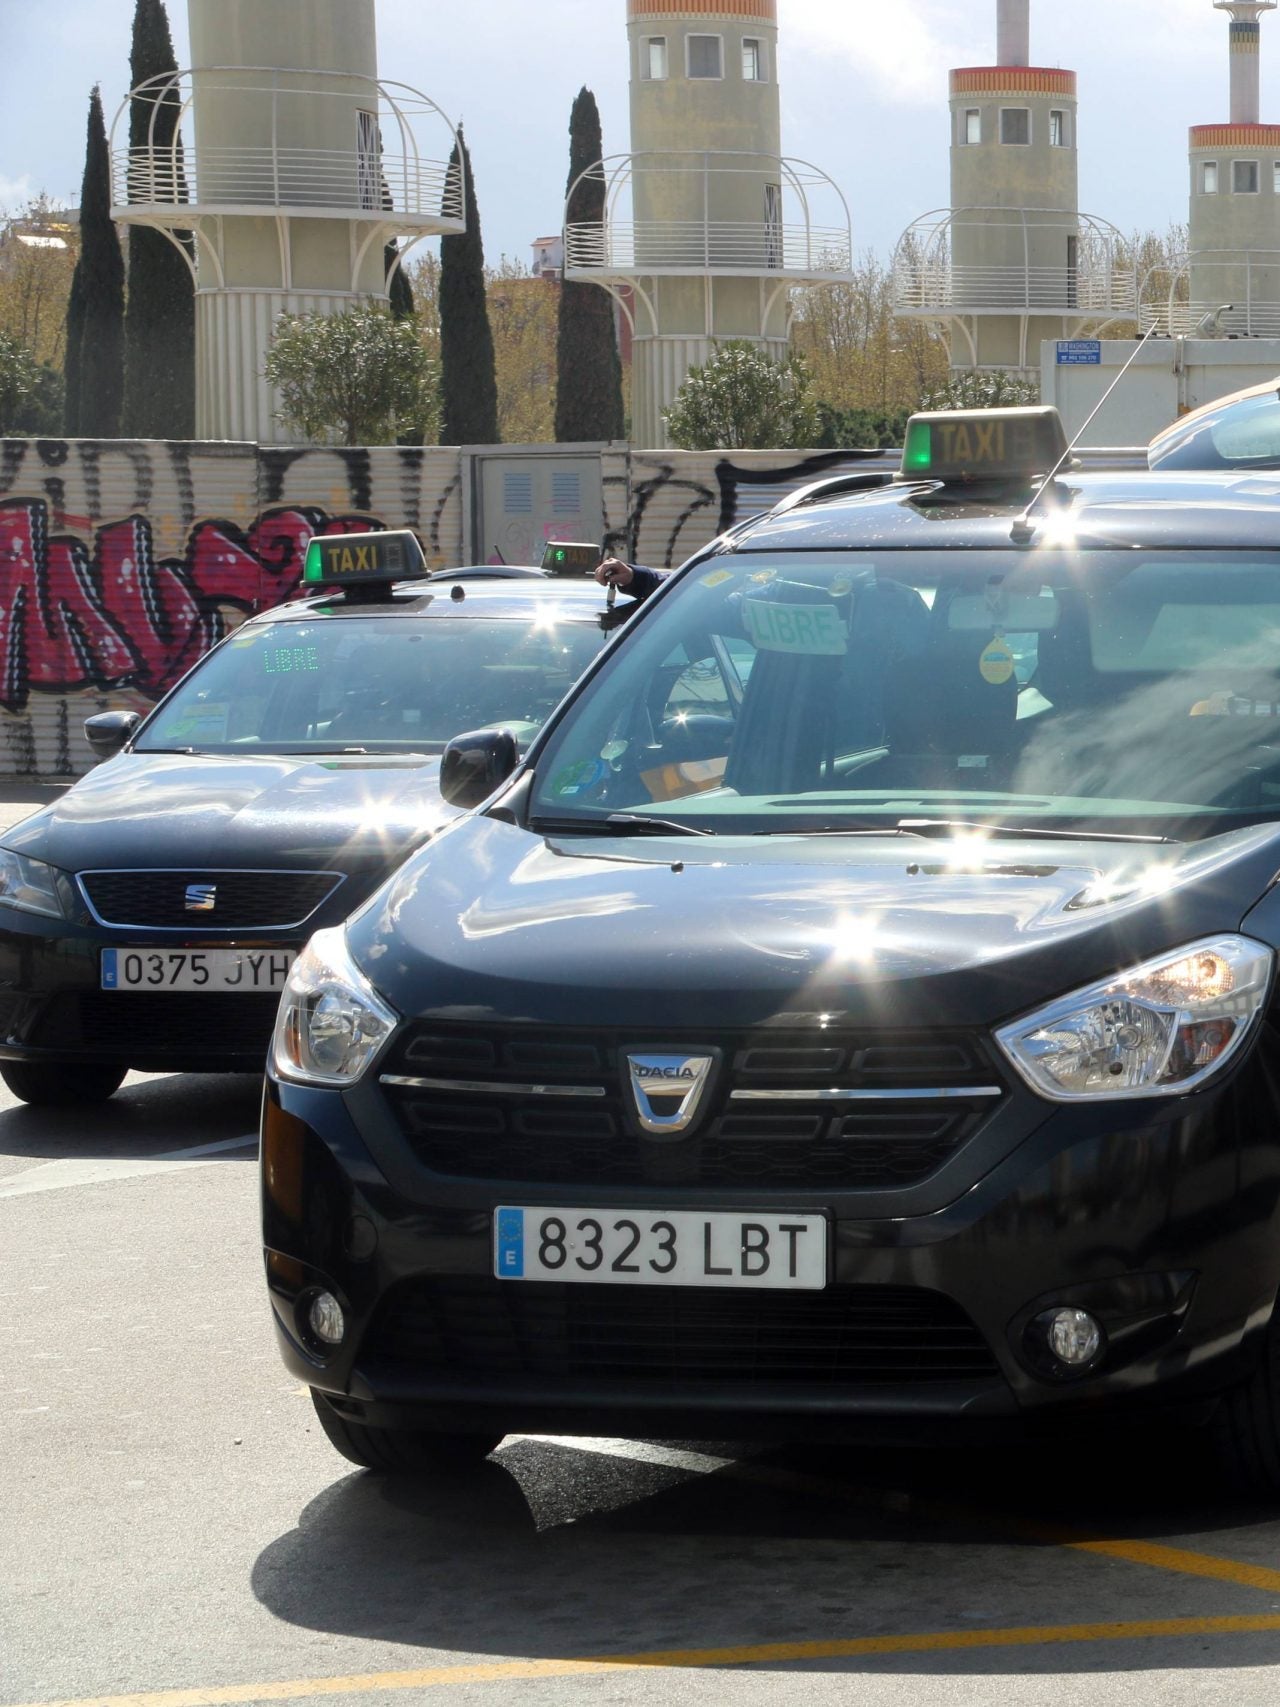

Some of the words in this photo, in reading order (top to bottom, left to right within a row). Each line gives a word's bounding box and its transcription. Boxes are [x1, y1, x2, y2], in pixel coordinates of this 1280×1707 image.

[937, 421, 1005, 463] TAXI
[328, 545, 378, 573] TAXI
[753, 605, 839, 644] LIBRE
[264, 647, 319, 673] LIBRE
[124, 954, 210, 985] 0375
[224, 954, 290, 986] JYH
[637, 1065, 694, 1078] DACIA
[505, 1250, 517, 1266] E
[538, 1216, 678, 1274] 8323
[703, 1221, 808, 1279] LBT
